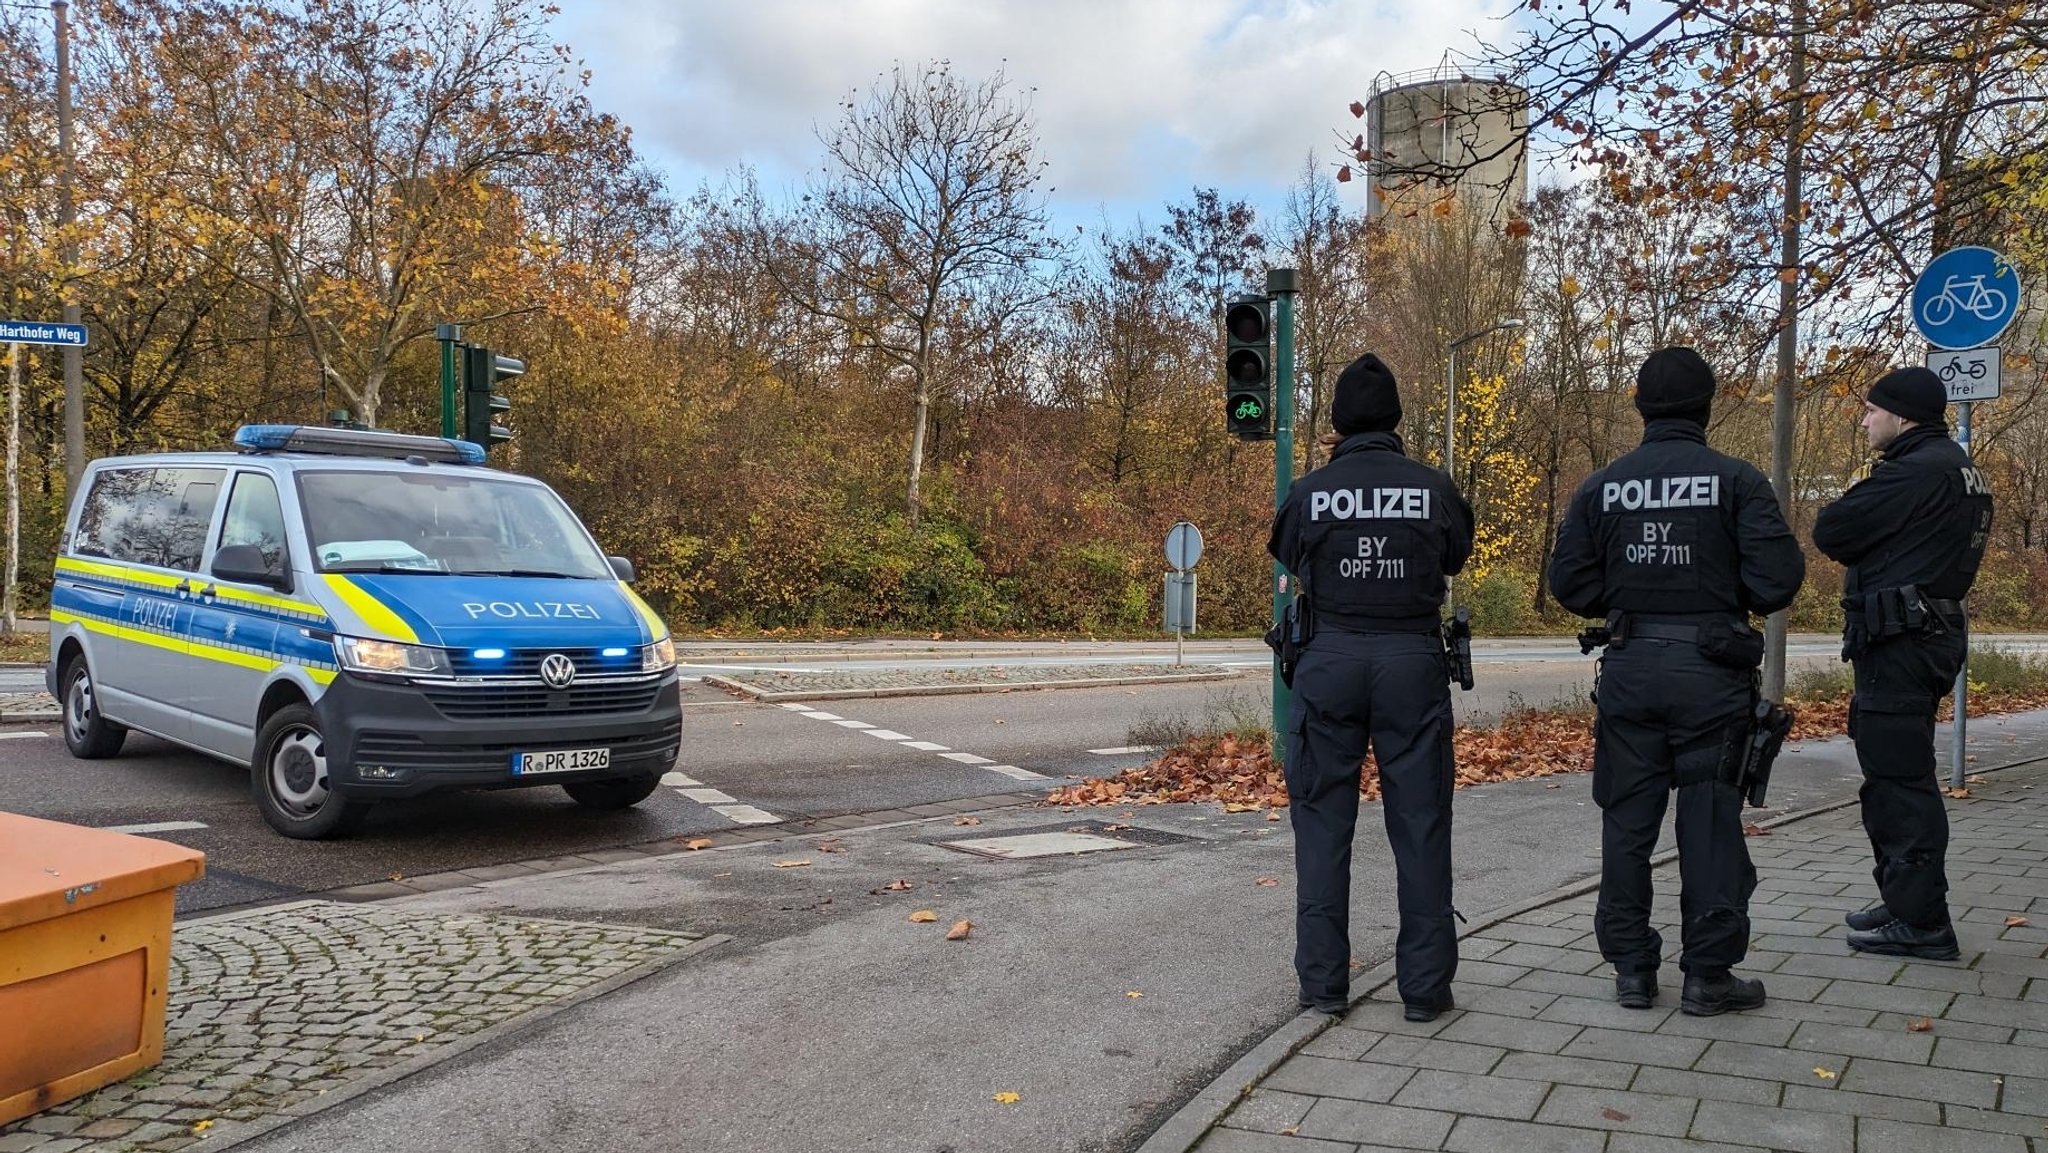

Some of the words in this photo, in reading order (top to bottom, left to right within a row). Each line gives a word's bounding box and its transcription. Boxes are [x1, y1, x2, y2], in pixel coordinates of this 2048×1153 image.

[0, 325, 54, 339] Harthofer
[56, 327, 80, 343] Weg
[1951, 384, 1974, 395] frei
[1603, 475, 1719, 512] POLIZEI
[1311, 488, 1430, 521] POLIZEI
[1643, 522, 1672, 542] BY
[1358, 536, 1388, 557] BY
[1626, 543, 1656, 564] OPF
[1661, 545, 1690, 565] 7111
[1340, 558, 1371, 578] OPF
[1377, 558, 1404, 579] 7111
[132, 597, 179, 631] POLIZEI
[462, 602, 601, 619] POLIZEI
[523, 755, 533, 771] R
[545, 753, 565, 770] PR
[570, 750, 607, 768] 1326
